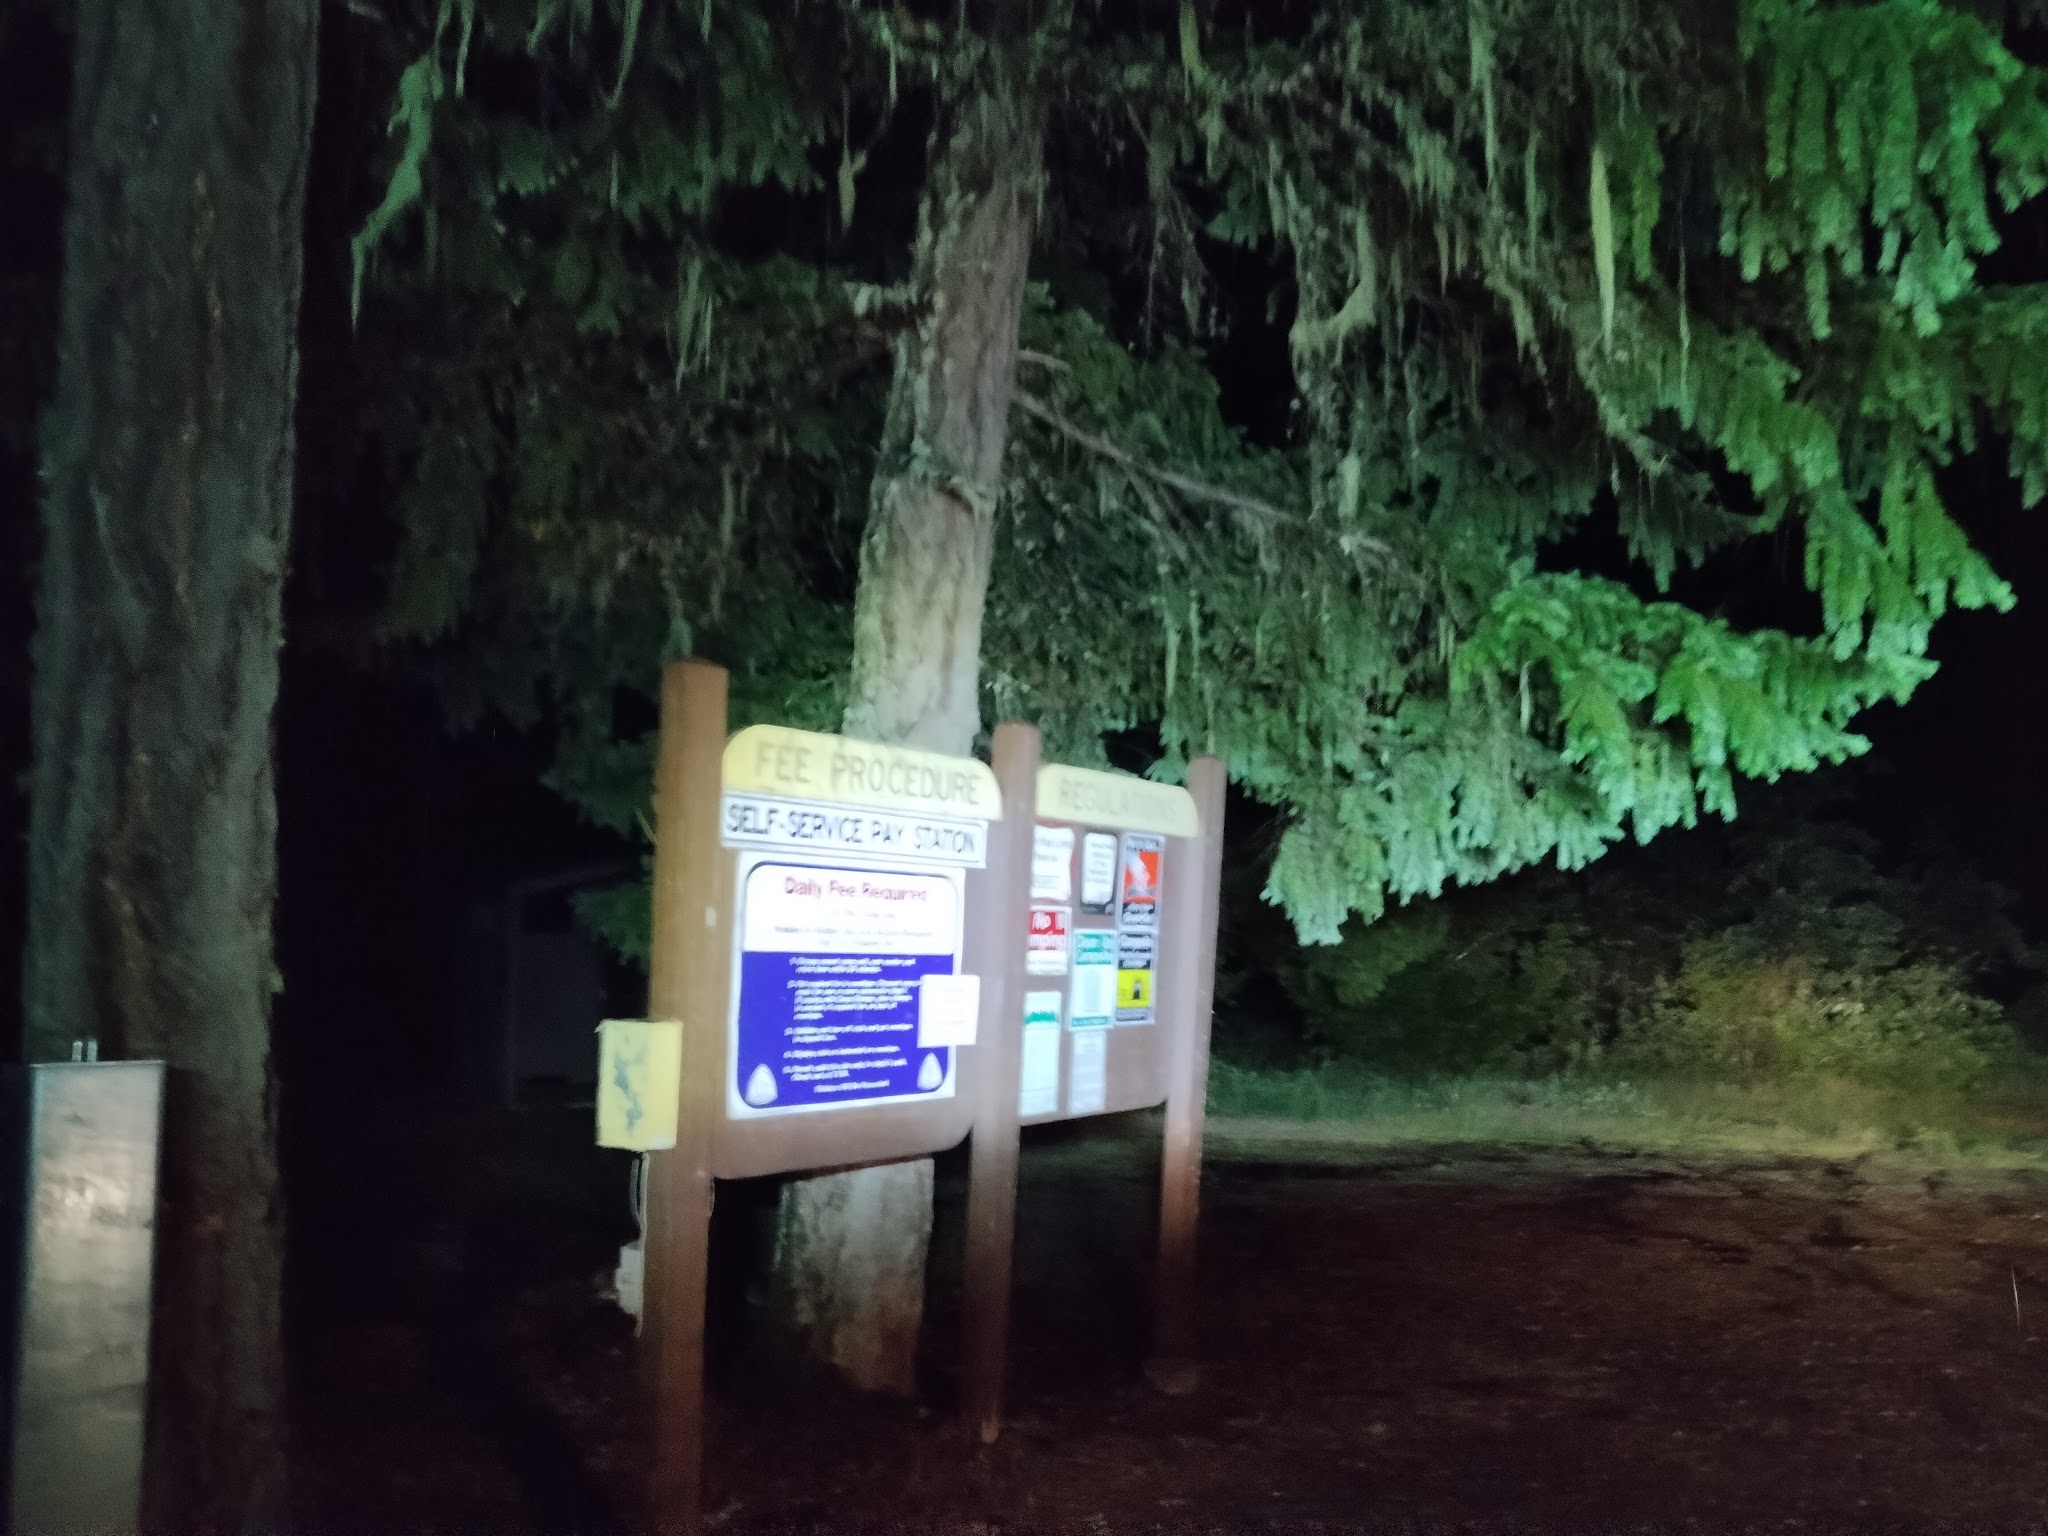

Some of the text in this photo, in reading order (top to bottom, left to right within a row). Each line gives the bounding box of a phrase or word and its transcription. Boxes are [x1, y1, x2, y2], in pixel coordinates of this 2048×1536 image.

[754, 741, 985, 806] FEE PROCEDURE
[1060, 777, 1176, 823] REGULATS
[727, 803, 864, 844] SELF-SERVICE
[871, 819, 904, 843] PAY
[784, 876, 822, 899] Daily
[830, 879, 856, 898] Fee
